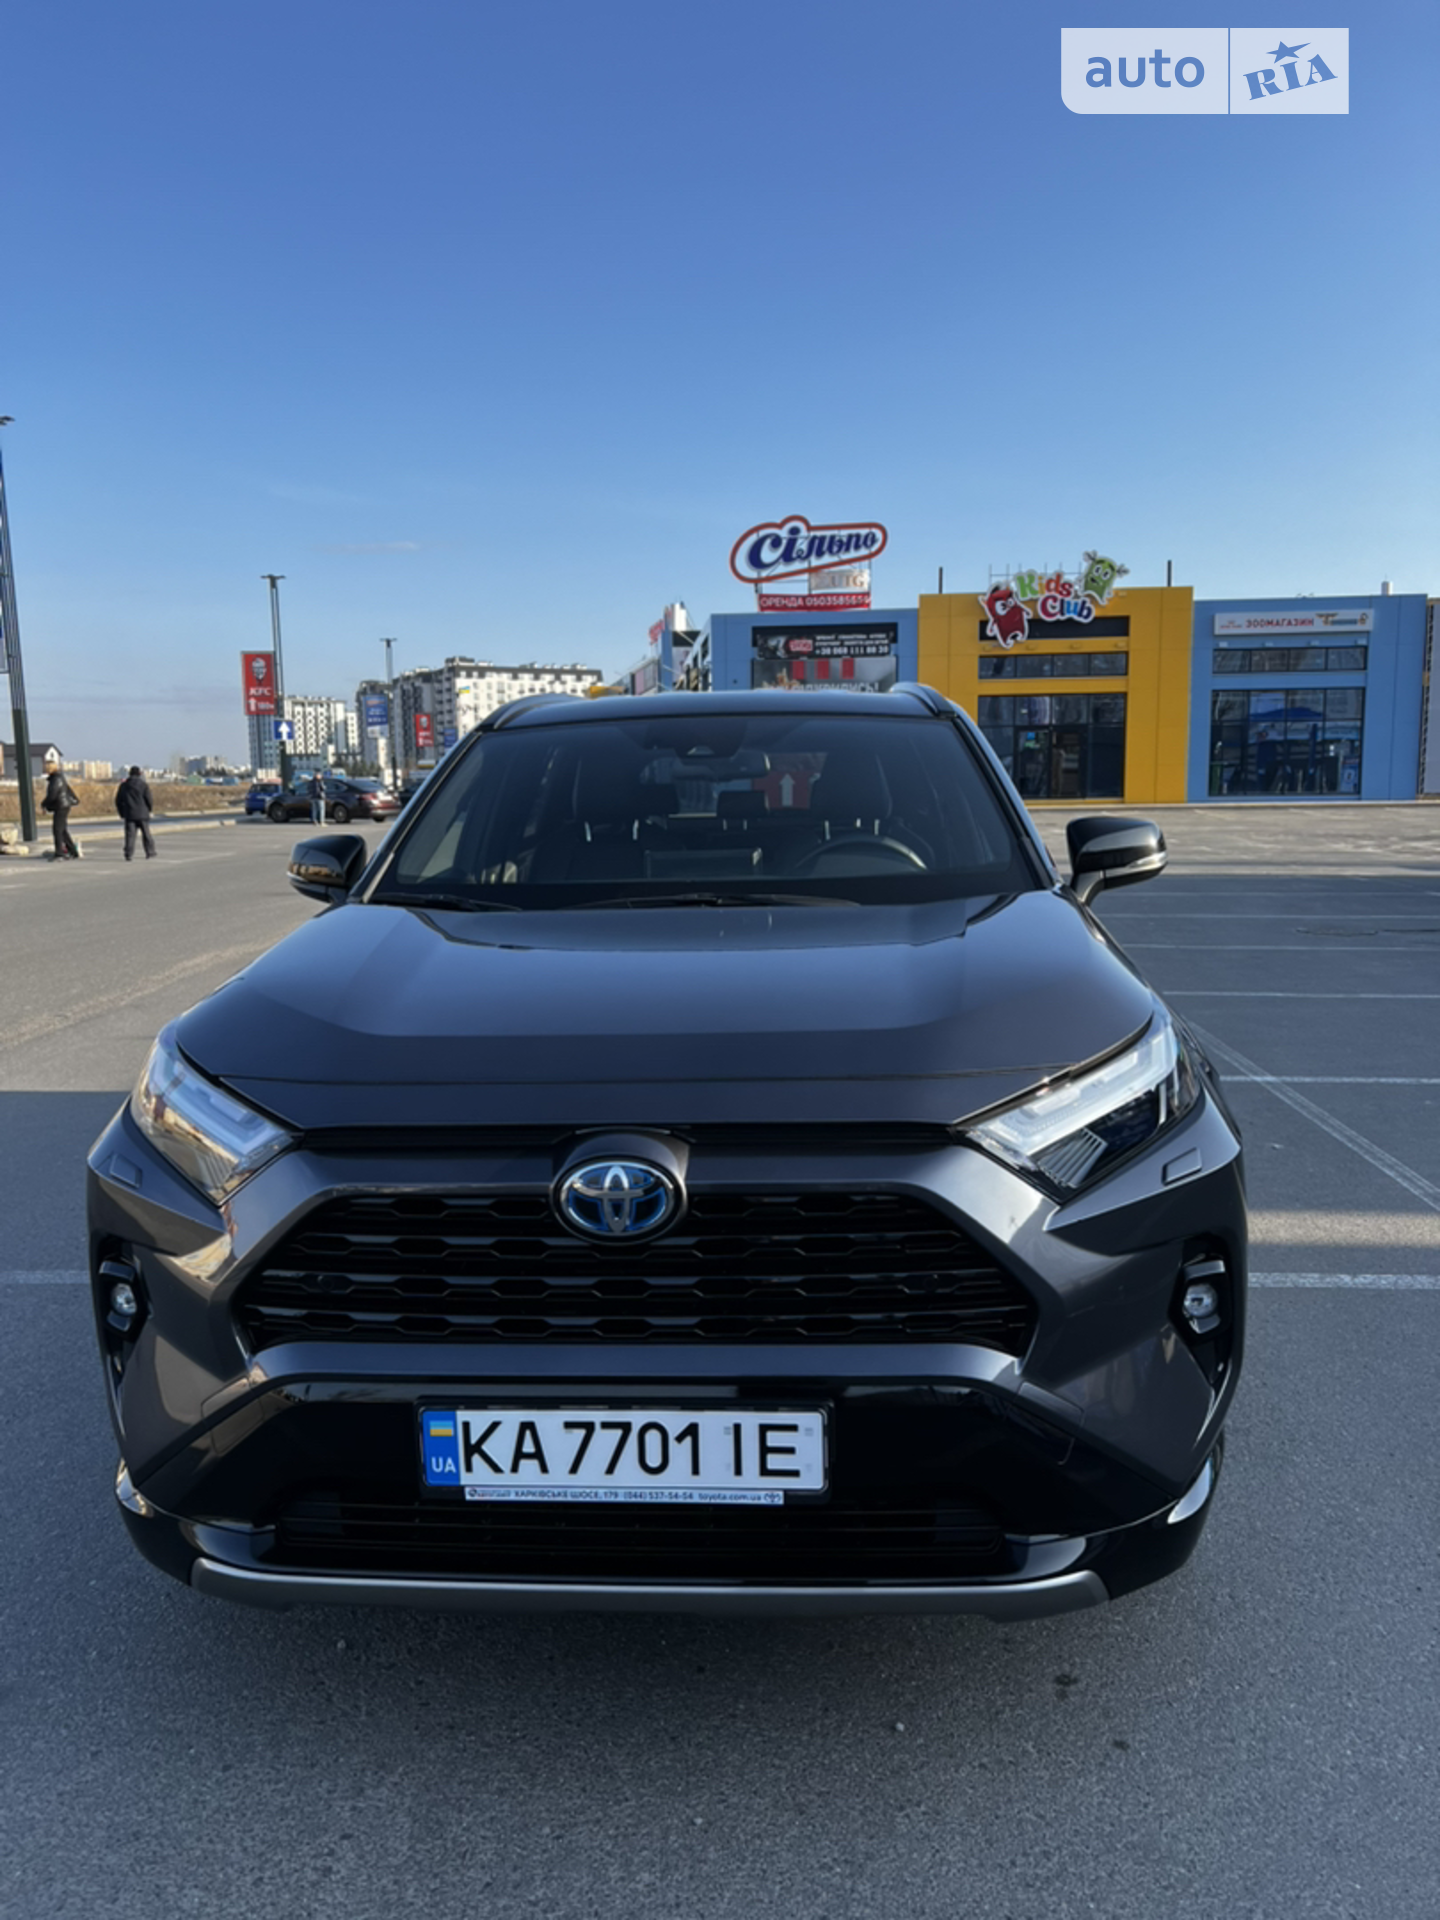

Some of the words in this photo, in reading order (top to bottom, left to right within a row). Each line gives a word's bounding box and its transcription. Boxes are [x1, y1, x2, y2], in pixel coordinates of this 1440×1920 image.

[747, 526, 878, 570] Сільпо
[1015, 572, 1073, 598] Kids
[760, 597, 804, 608] ОРЕНДА
[1039, 595, 1093, 620] Club
[1245, 618, 1315, 629] ЗООМАГАЗИН
[249, 687, 271, 696] KFC
[462, 1420, 550, 1475] KA
[563, 1421, 701, 1476] 7701
[733, 1423, 801, 1478] IE
[431, 1456, 457, 1474] UA
[514, 1489, 568, 1499] ХАРКІВСЬКЕ
[604, 1490, 618, 1499] 179
[623, 1490, 647, 1501] (044)
[698, 1492, 761, 1503] toyota.com.ua
